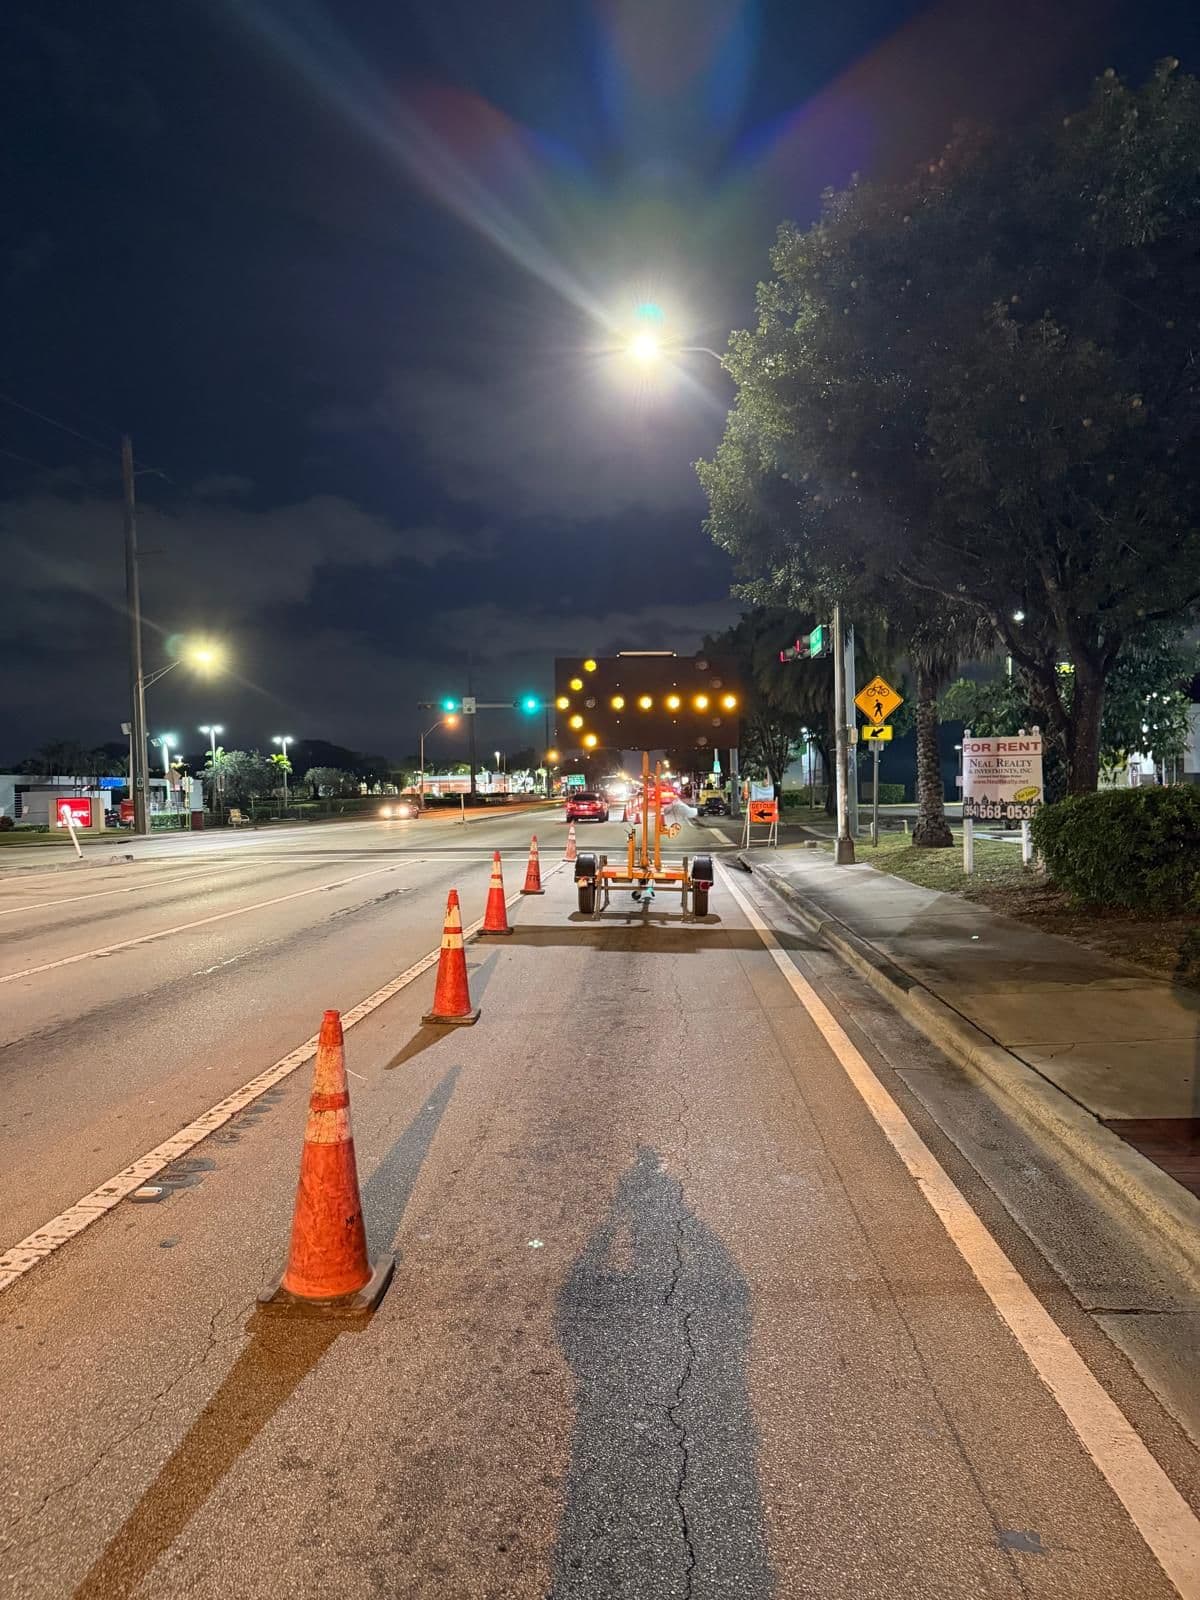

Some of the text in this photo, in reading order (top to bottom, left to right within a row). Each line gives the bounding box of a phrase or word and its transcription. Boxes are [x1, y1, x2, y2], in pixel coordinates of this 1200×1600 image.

[963, 742, 1041, 753] FOR RENT
[969, 758, 1032, 768] NEAL REALTY
